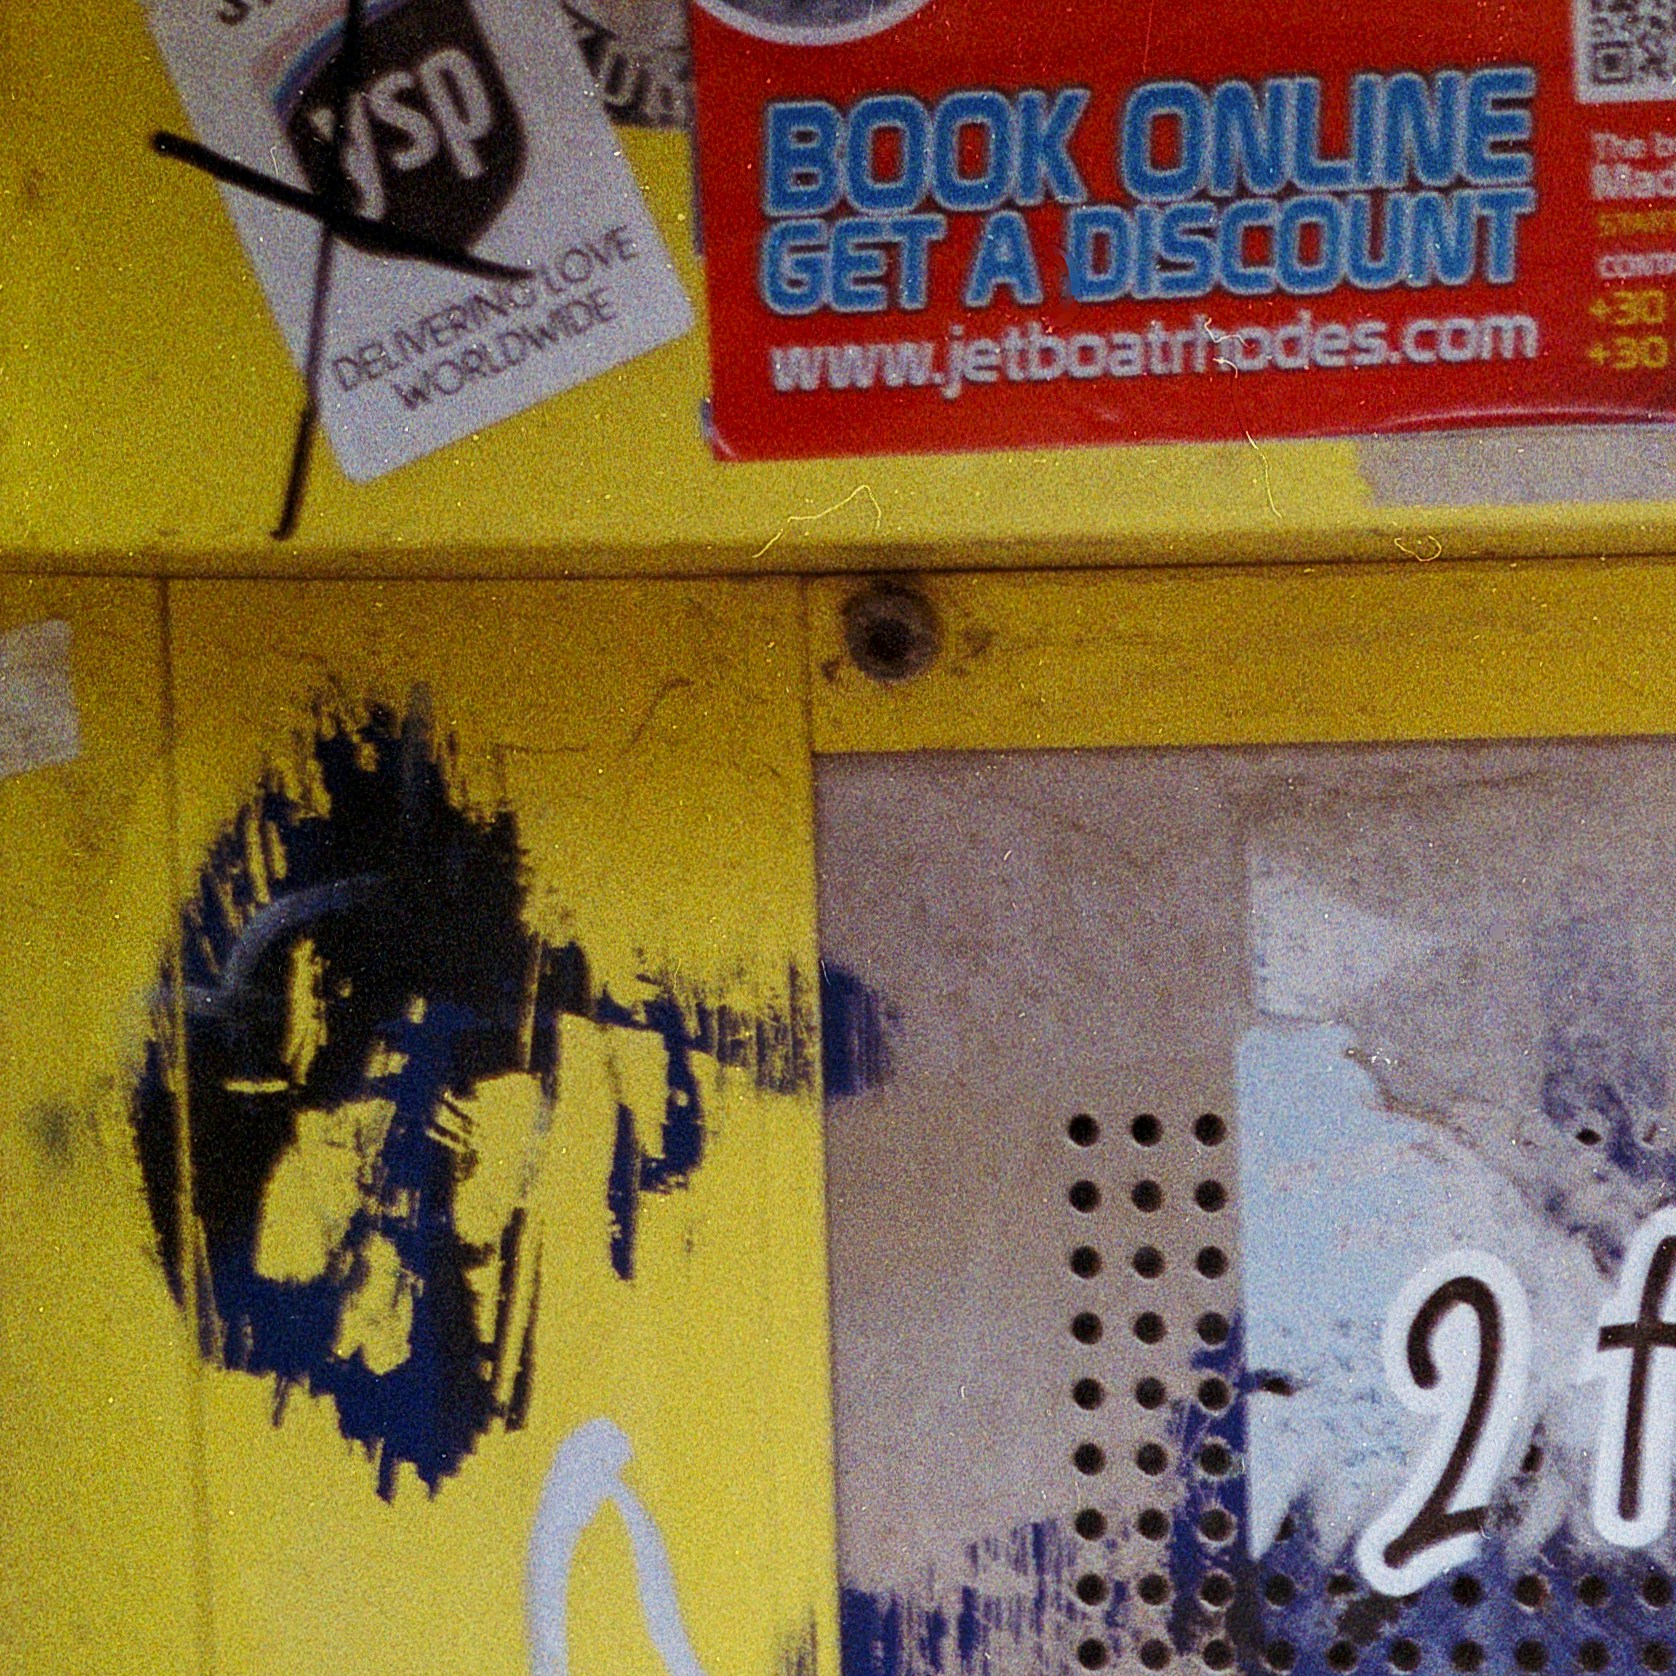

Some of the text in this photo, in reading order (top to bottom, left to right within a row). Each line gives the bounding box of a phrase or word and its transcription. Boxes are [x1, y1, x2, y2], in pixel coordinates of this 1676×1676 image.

[762, 67, 1537, 217] BOOK ONLINE
[1591, 131, 1646, 159] The
[758, 187, 1537, 317] GET A DISCOUNT
[331, 224, 641, 392] DELIVERING LOVE
[392, 286, 618, 411] WORLDWIDE
[771, 308, 1539, 401] www.jetboatrhodes.com
[1586, 335, 1668, 370] +30
[1588, 289, 1667, 326] +30
